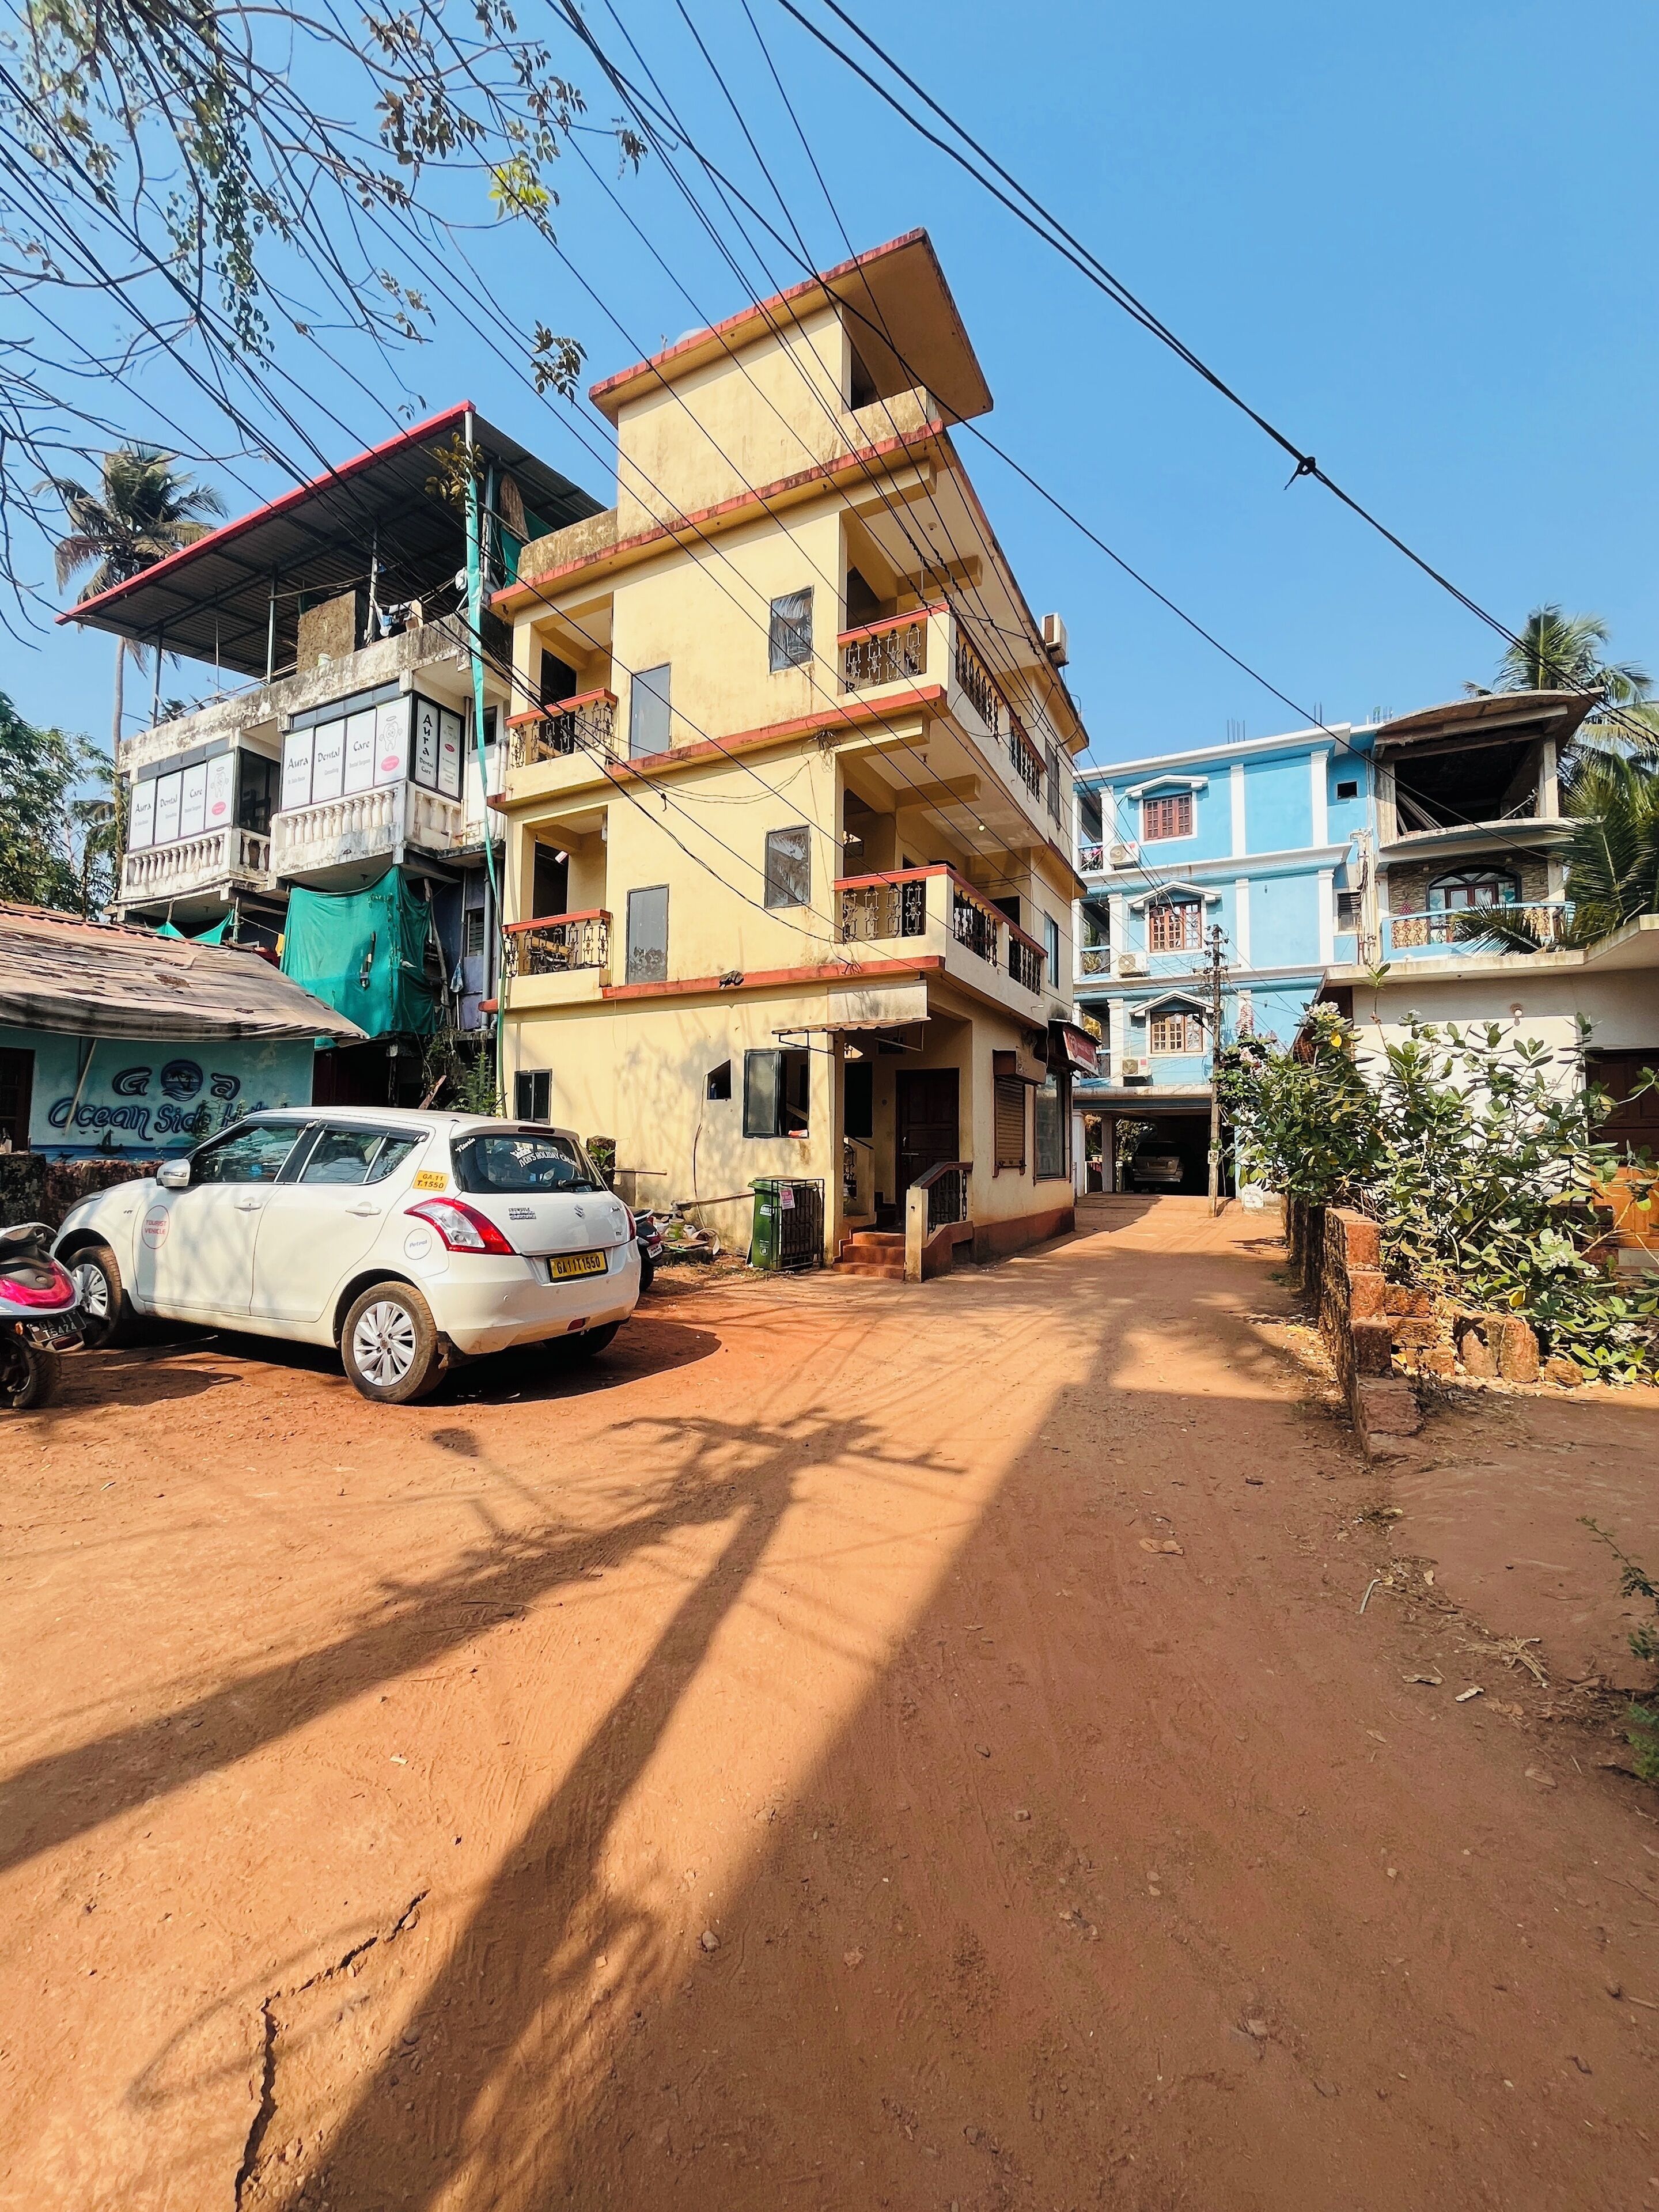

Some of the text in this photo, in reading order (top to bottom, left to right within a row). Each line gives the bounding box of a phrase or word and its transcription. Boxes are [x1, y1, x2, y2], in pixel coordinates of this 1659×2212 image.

[423, 714, 432, 756] Aura
[287, 741, 370, 770] Aura Dental Care
[419, 757, 433, 768] Dental
[421, 766, 431, 775] Care
[135, 789, 202, 813] Aura Dental Care
[48, 1097, 153, 1141] Ocean
[535, 1152, 559, 1160] HOLIDAY
[417, 1180, 444, 1188] T.1550
[556, 1256, 600, 1274] GA11T1550
[43, 1322, 77, 1338] T5424
